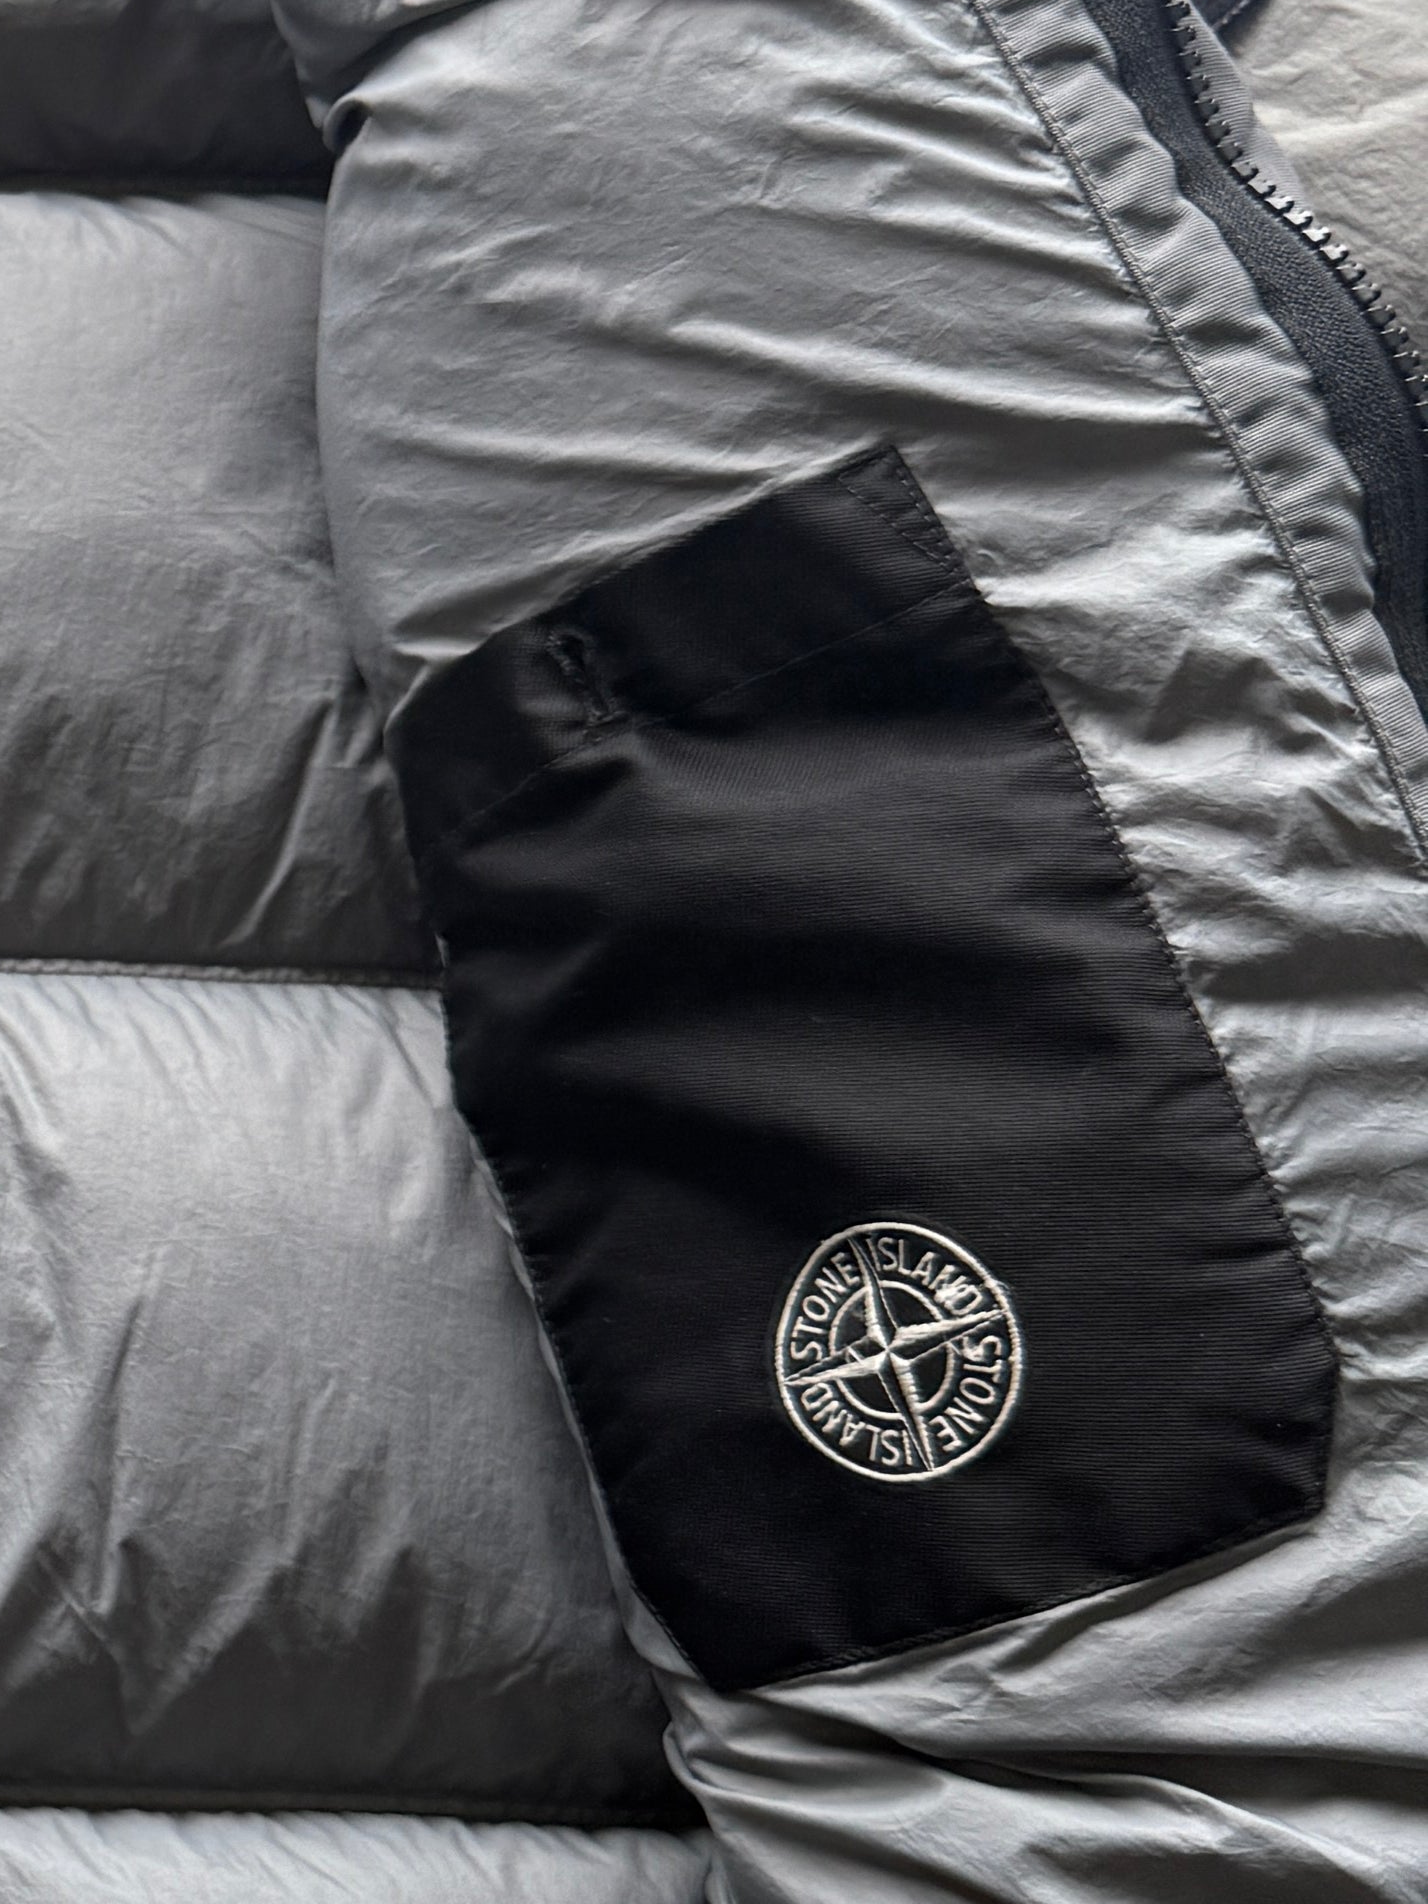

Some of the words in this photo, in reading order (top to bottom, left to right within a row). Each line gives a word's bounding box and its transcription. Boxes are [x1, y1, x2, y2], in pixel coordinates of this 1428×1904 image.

[790, 1252, 860, 1361] STONE
[865, 1236, 983, 1316] ISLAND
[800, 1382, 913, 1466] ISLAND
[929, 1334, 1002, 1452] STONE
